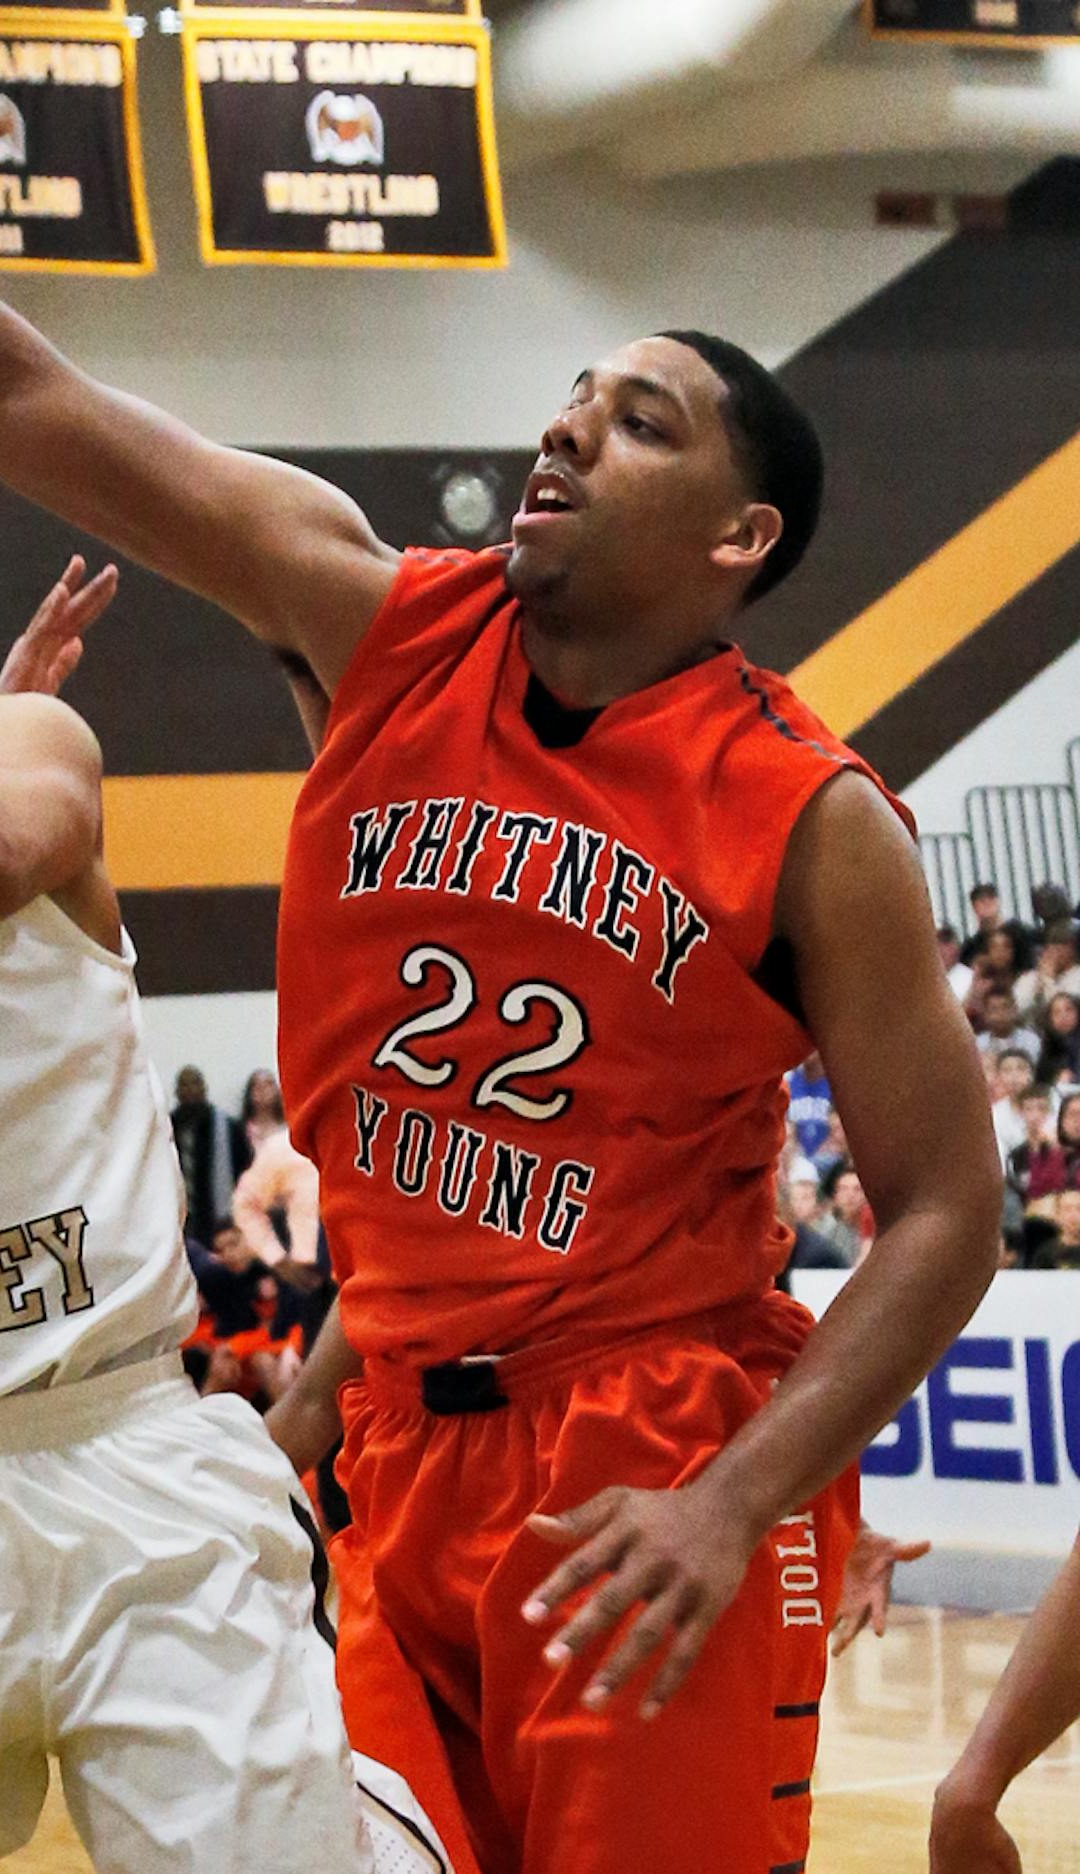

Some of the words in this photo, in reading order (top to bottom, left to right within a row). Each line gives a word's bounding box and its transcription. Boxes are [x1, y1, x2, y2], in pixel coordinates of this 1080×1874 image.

[197, 41, 300, 83] STATE
[306, 42, 477, 88] CHAMPIONS
[263, 171, 440, 217] WRESTLING
[340, 797, 709, 1005] WHITNEY
[372, 942, 591, 1122] 22
[352, 1084, 595, 1254] YOUNG
